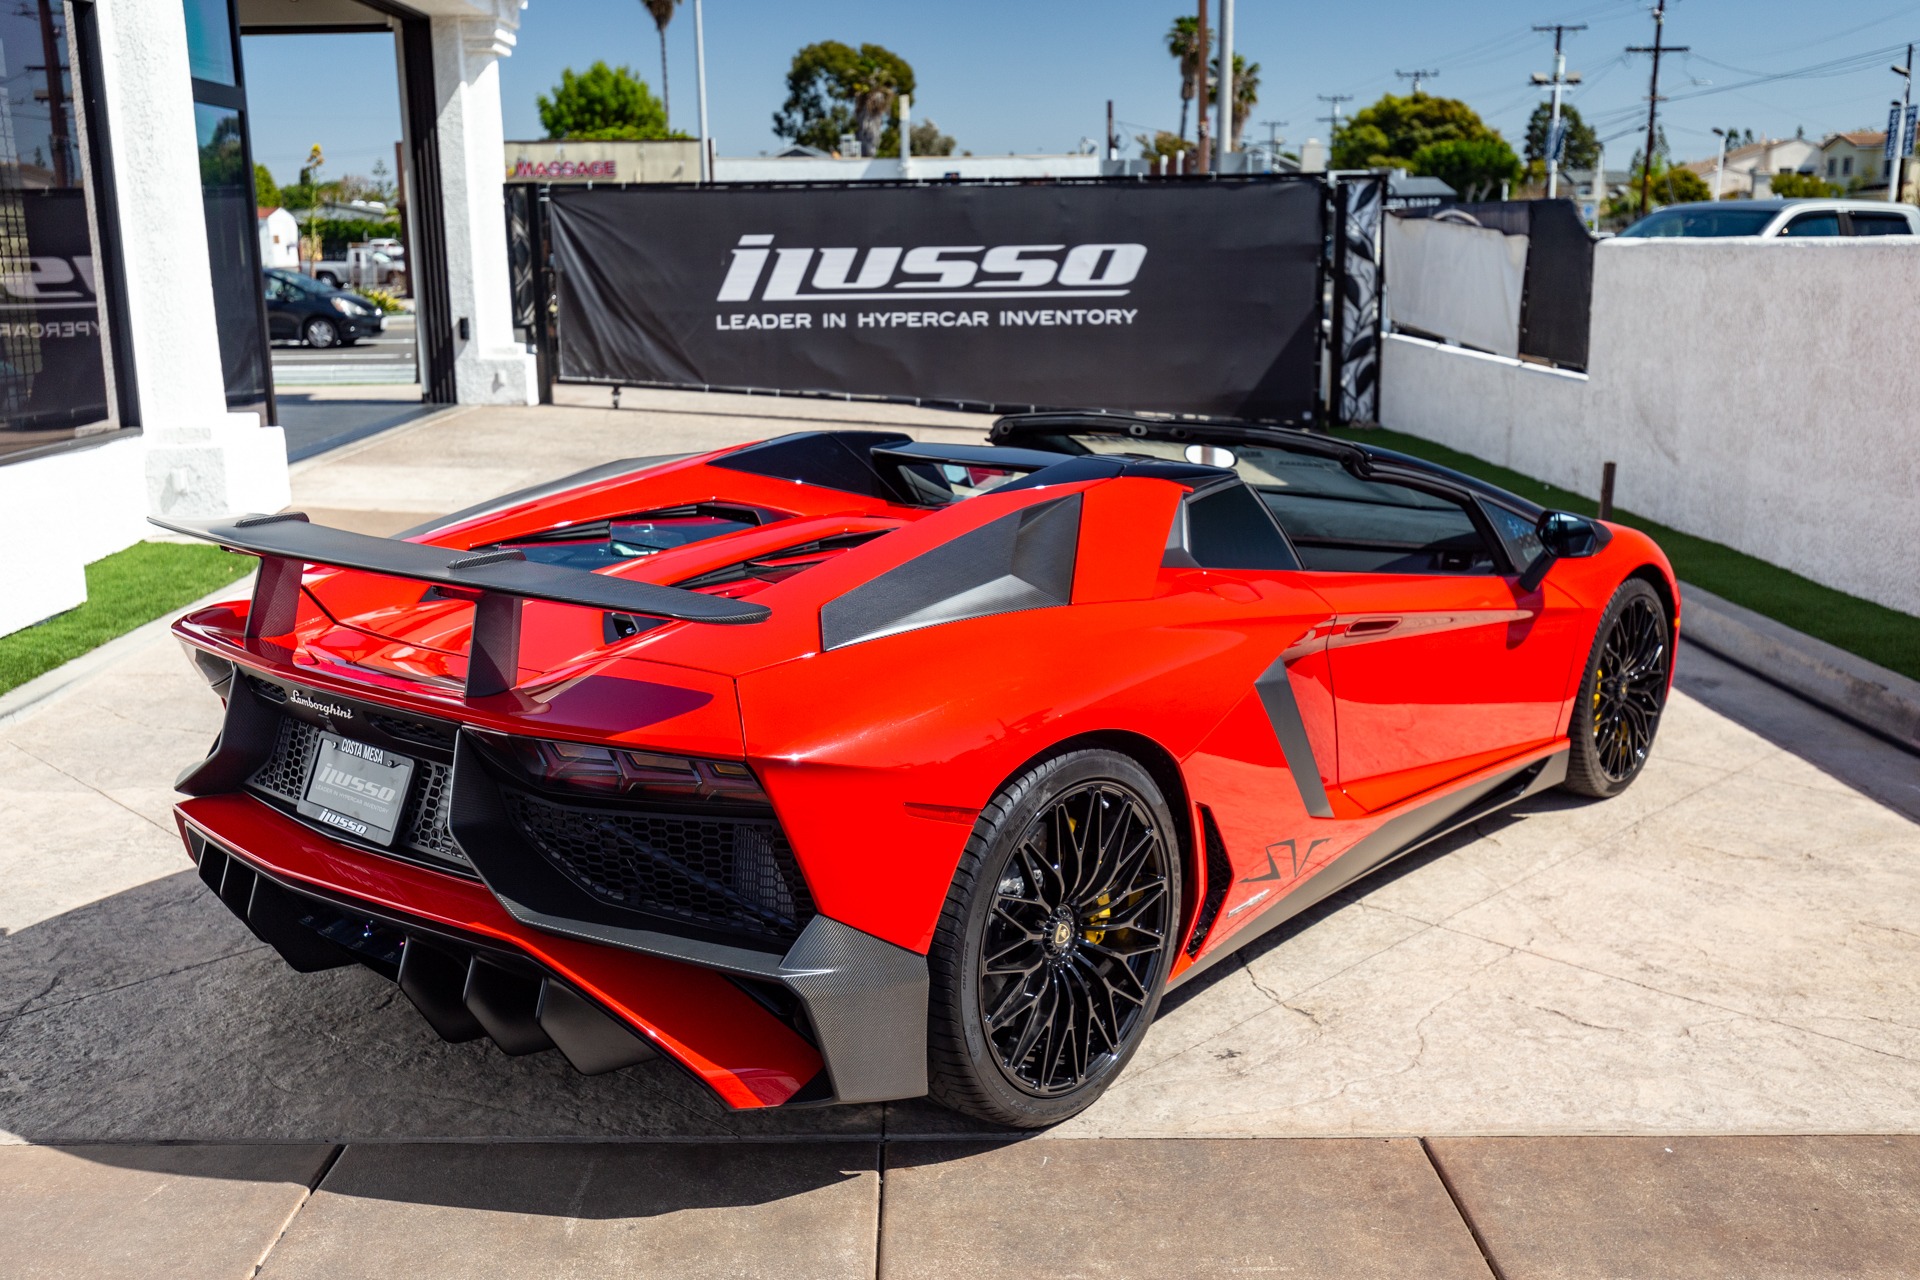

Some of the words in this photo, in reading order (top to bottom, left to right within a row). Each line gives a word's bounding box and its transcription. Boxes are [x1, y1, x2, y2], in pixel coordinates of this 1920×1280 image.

[517, 161, 616, 177] MASSAGE
[716, 313, 812, 331] LEADER
[823, 313, 847, 329] IN
[858, 311, 989, 329] HYPERCAR
[1000, 308, 1138, 327] INVENTORY
[290, 689, 354, 719] Lamborghini
[341, 738, 362, 758] COSTA
[362, 745, 384, 764] MESA
[315, 784, 333, 794] LEADER
[339, 791, 363, 804] HYPERCAR
[363, 799, 389, 813] INVENTORY
[1238, 838, 1332, 883] SV
